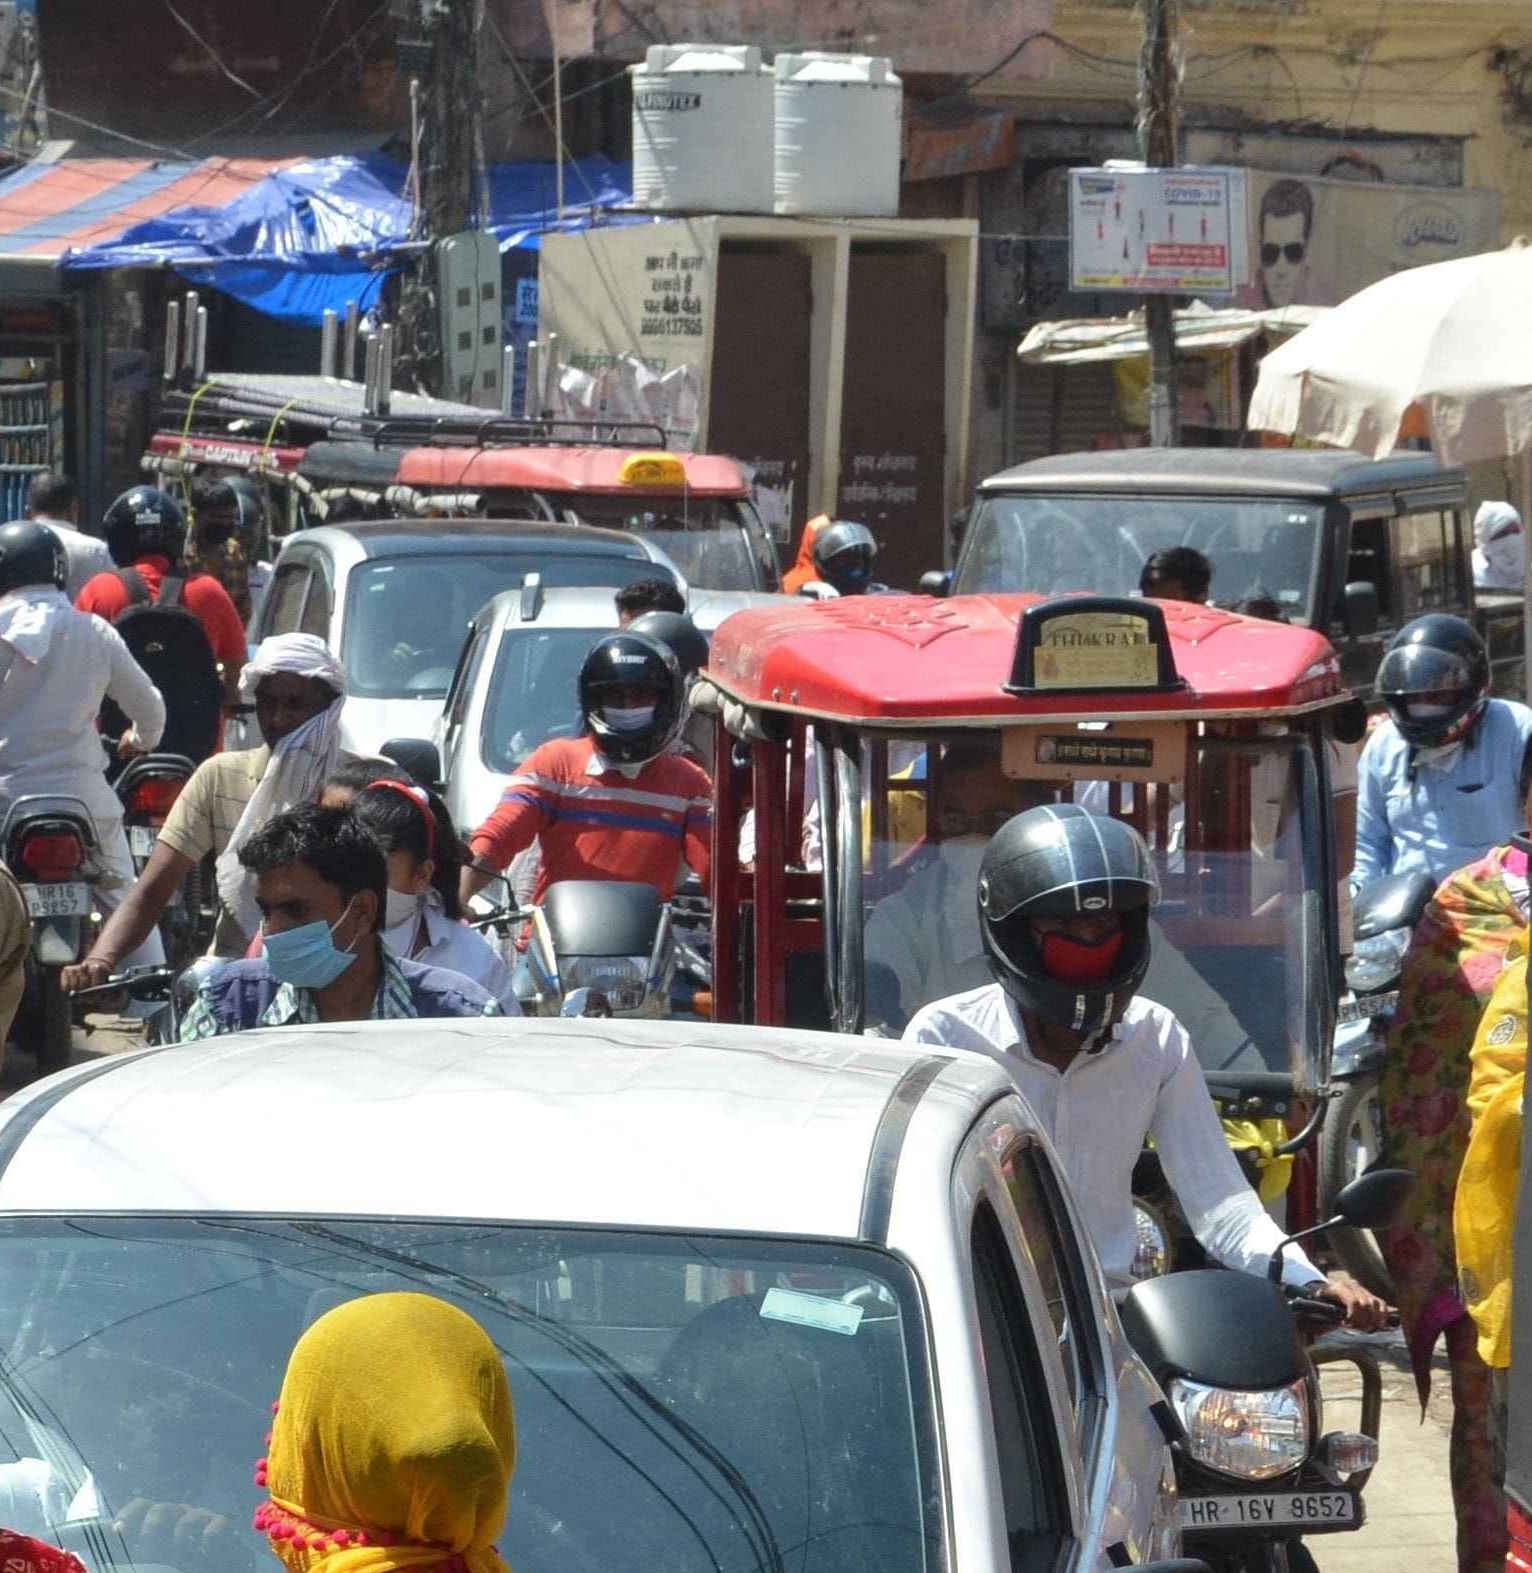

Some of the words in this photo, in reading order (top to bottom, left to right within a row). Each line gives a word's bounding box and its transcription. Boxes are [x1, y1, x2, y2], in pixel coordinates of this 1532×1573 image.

[1165, 189, 1221, 199] COVID-19
[37, 884, 75, 899] HR16
[1190, 1500, 1220, 1524] HR
[1237, 1498, 1275, 1522] 16V
[1290, 1495, 1347, 1520] 9652
